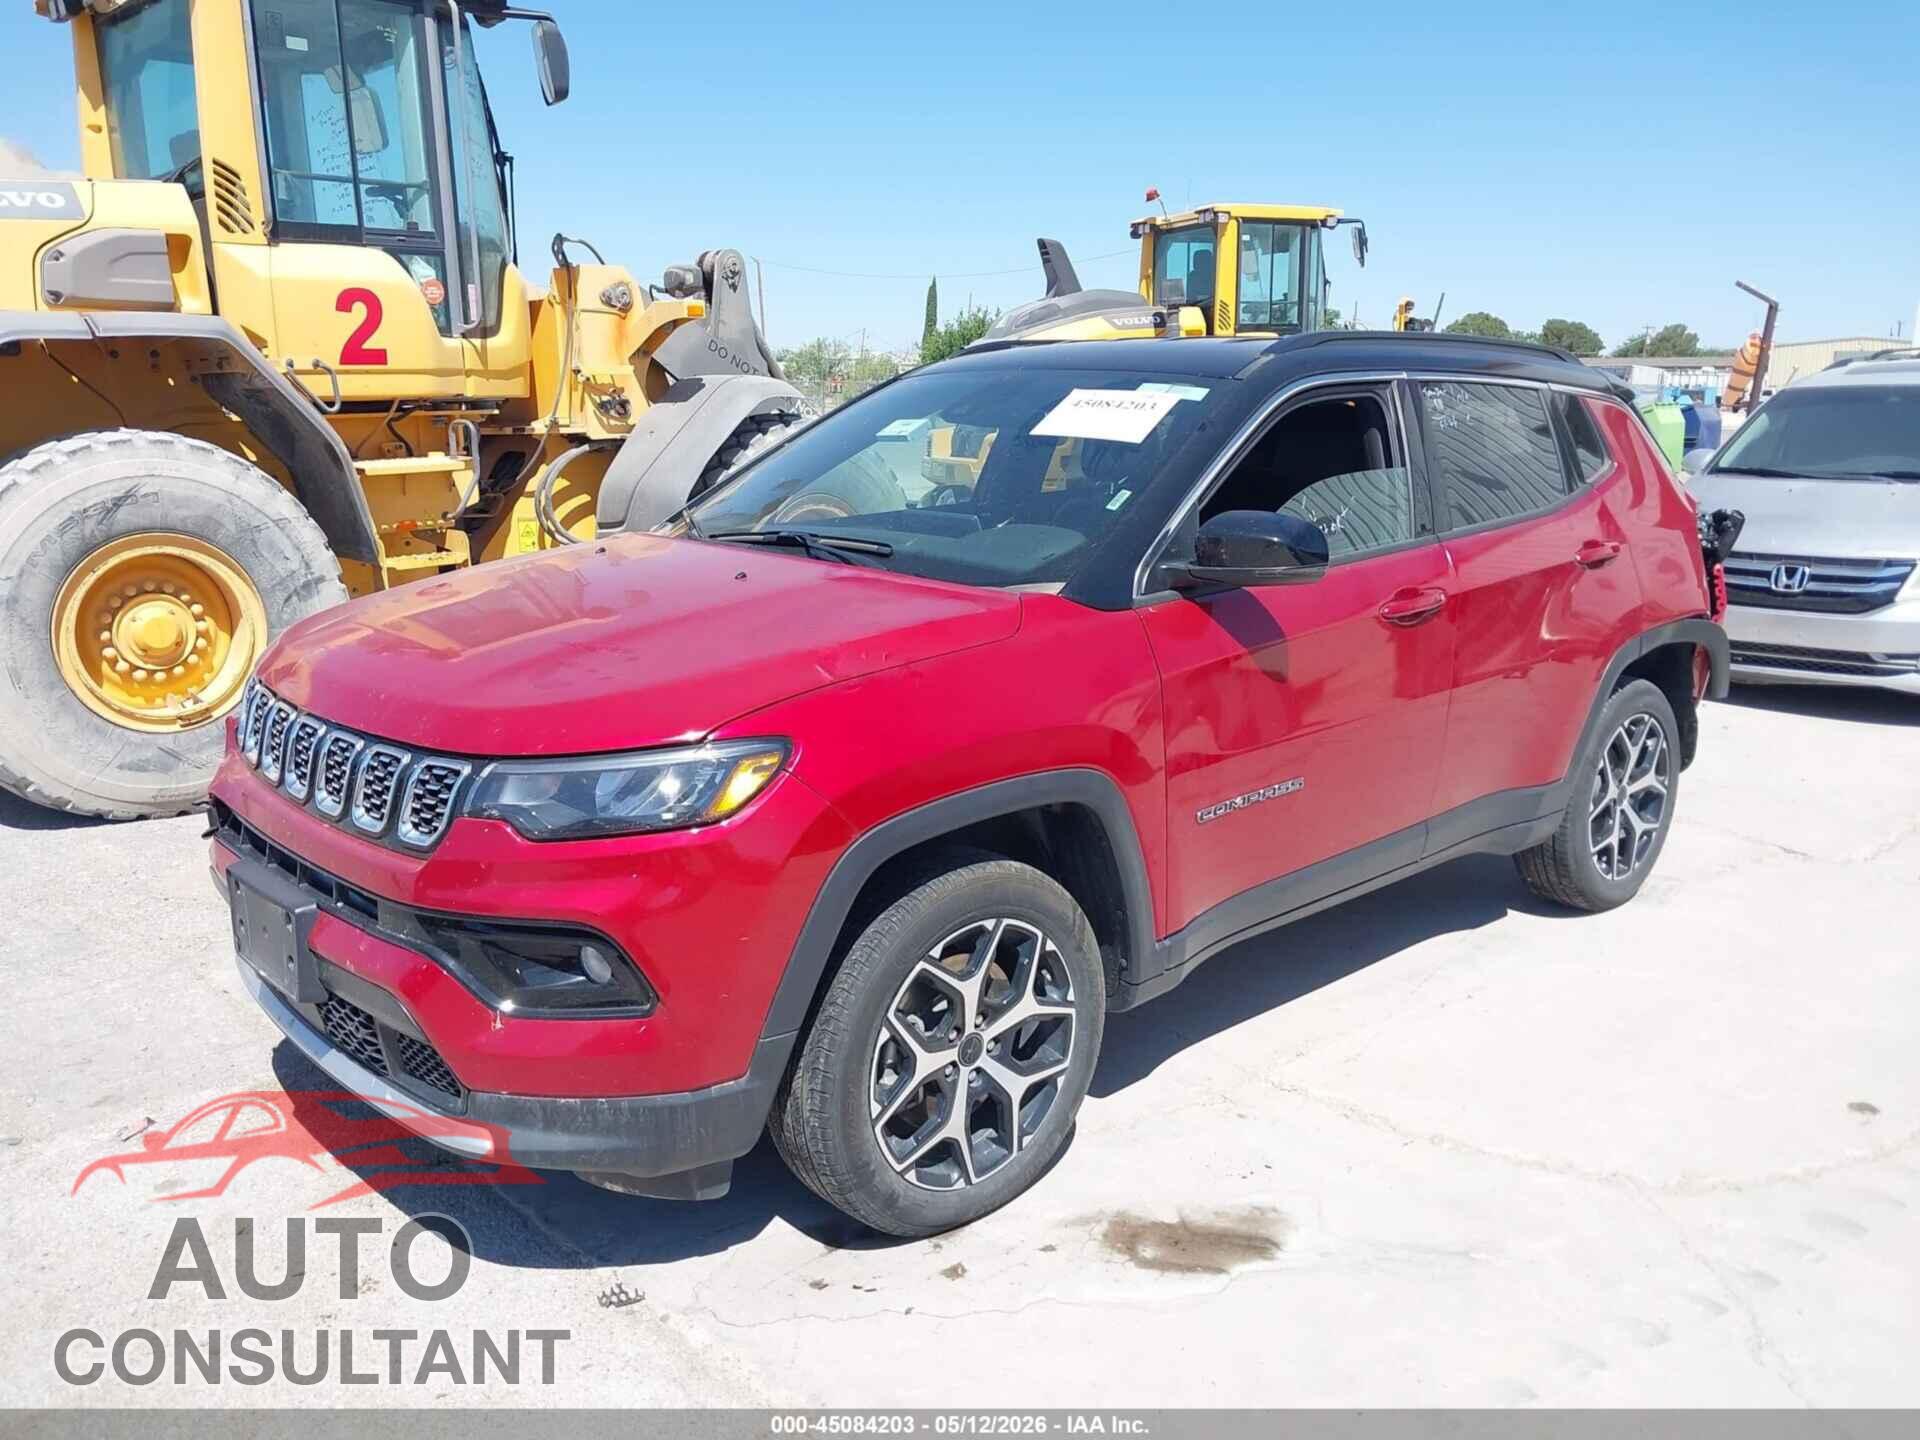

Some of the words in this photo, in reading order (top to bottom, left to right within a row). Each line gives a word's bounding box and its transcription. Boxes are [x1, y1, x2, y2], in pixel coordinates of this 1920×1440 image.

[0, 191, 65, 208] VO
[335, 287, 388, 366] 2
[1111, 315, 1161, 326] VOLVO
[708, 339, 729, 359] DO
[730, 354, 760, 375] NOT
[1196, 777, 1305, 824] COMPASS
